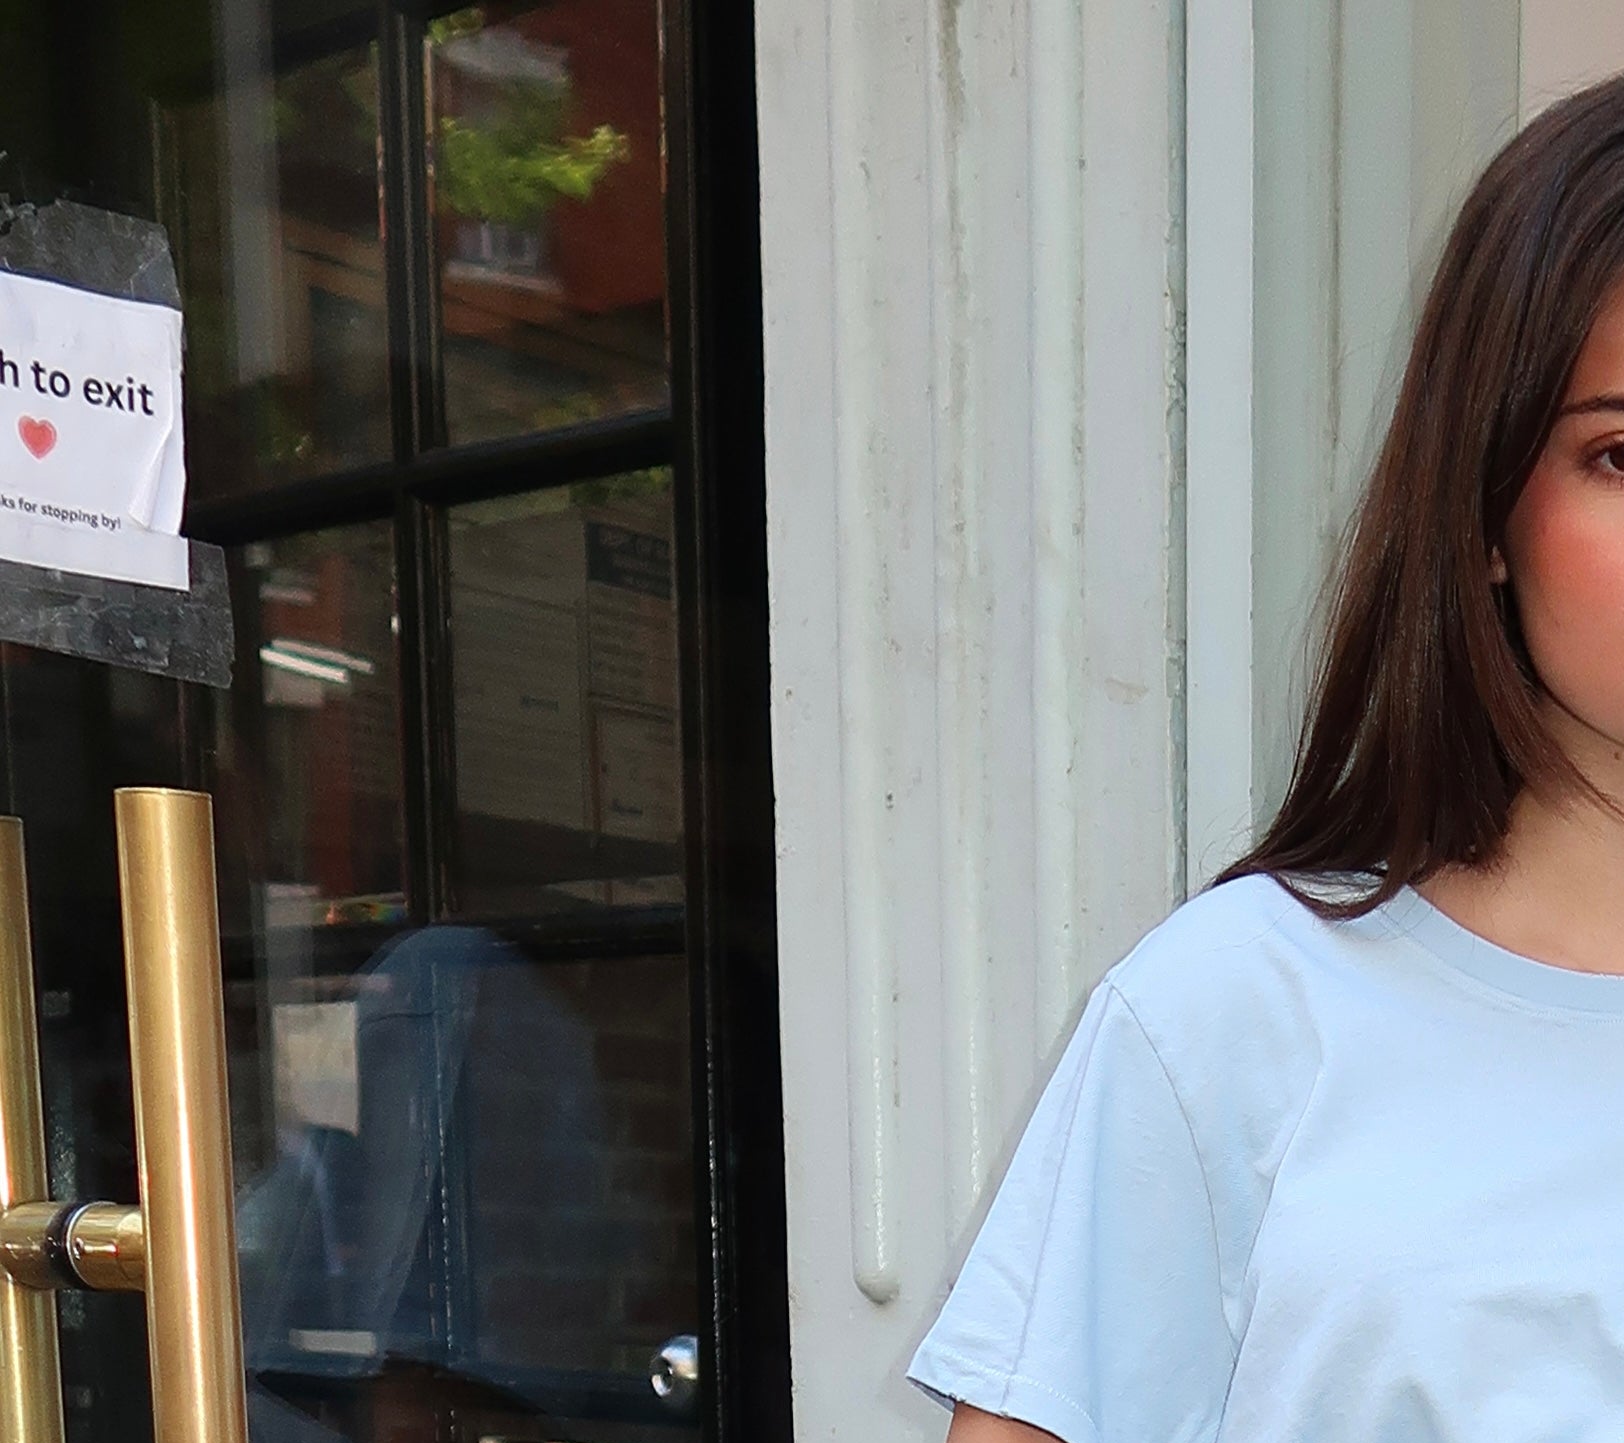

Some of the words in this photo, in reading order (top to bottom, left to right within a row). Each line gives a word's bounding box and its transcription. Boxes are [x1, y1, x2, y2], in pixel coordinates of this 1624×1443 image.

[30, 360, 70, 398] to
[83, 376, 154, 416] exit
[18, 497, 38, 513] for
[41, 504, 99, 529] stopping
